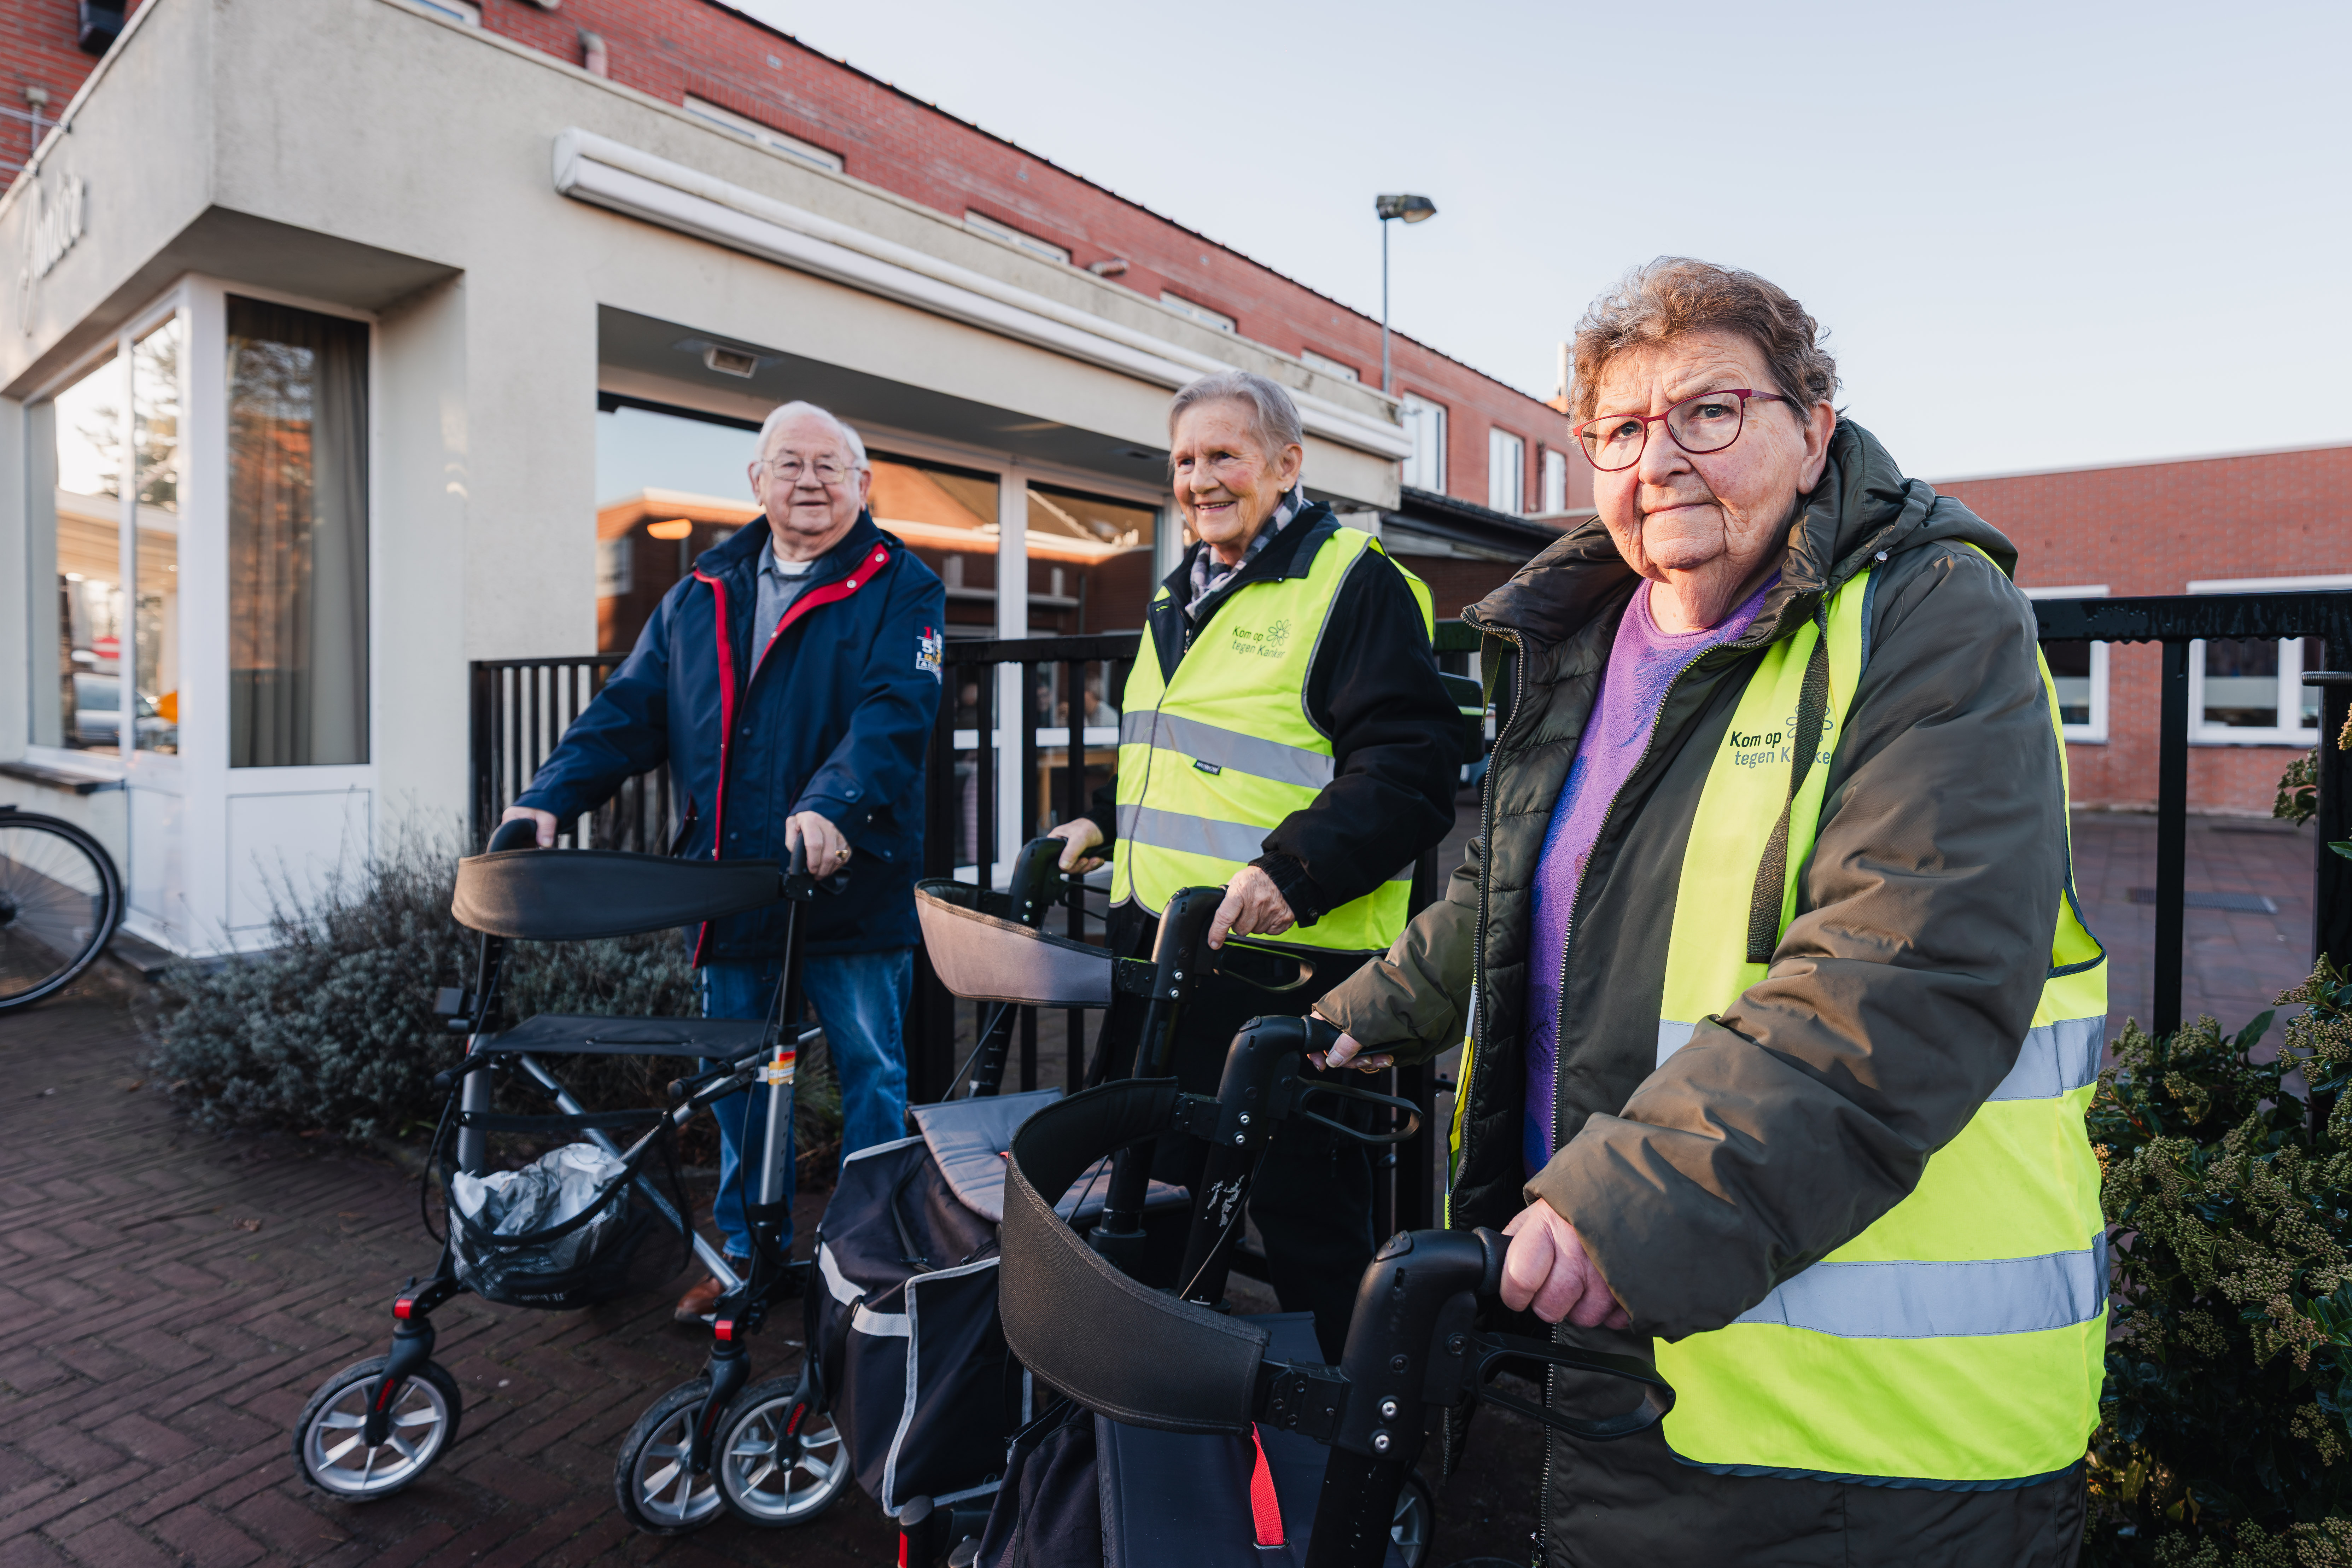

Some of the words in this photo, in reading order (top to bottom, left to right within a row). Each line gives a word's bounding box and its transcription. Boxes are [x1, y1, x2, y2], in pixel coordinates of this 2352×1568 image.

[1232, 625, 1251, 639] Kom
[1253, 633, 1263, 643] op
[1232, 639, 1255, 654] tegen
[1257, 645, 1285, 658] Kanker
[1730, 731, 1761, 747] Kom
[1765, 732, 1781, 748] op
[1735, 751, 1774, 769] tegen
[1780, 746, 1830, 765] Kke
